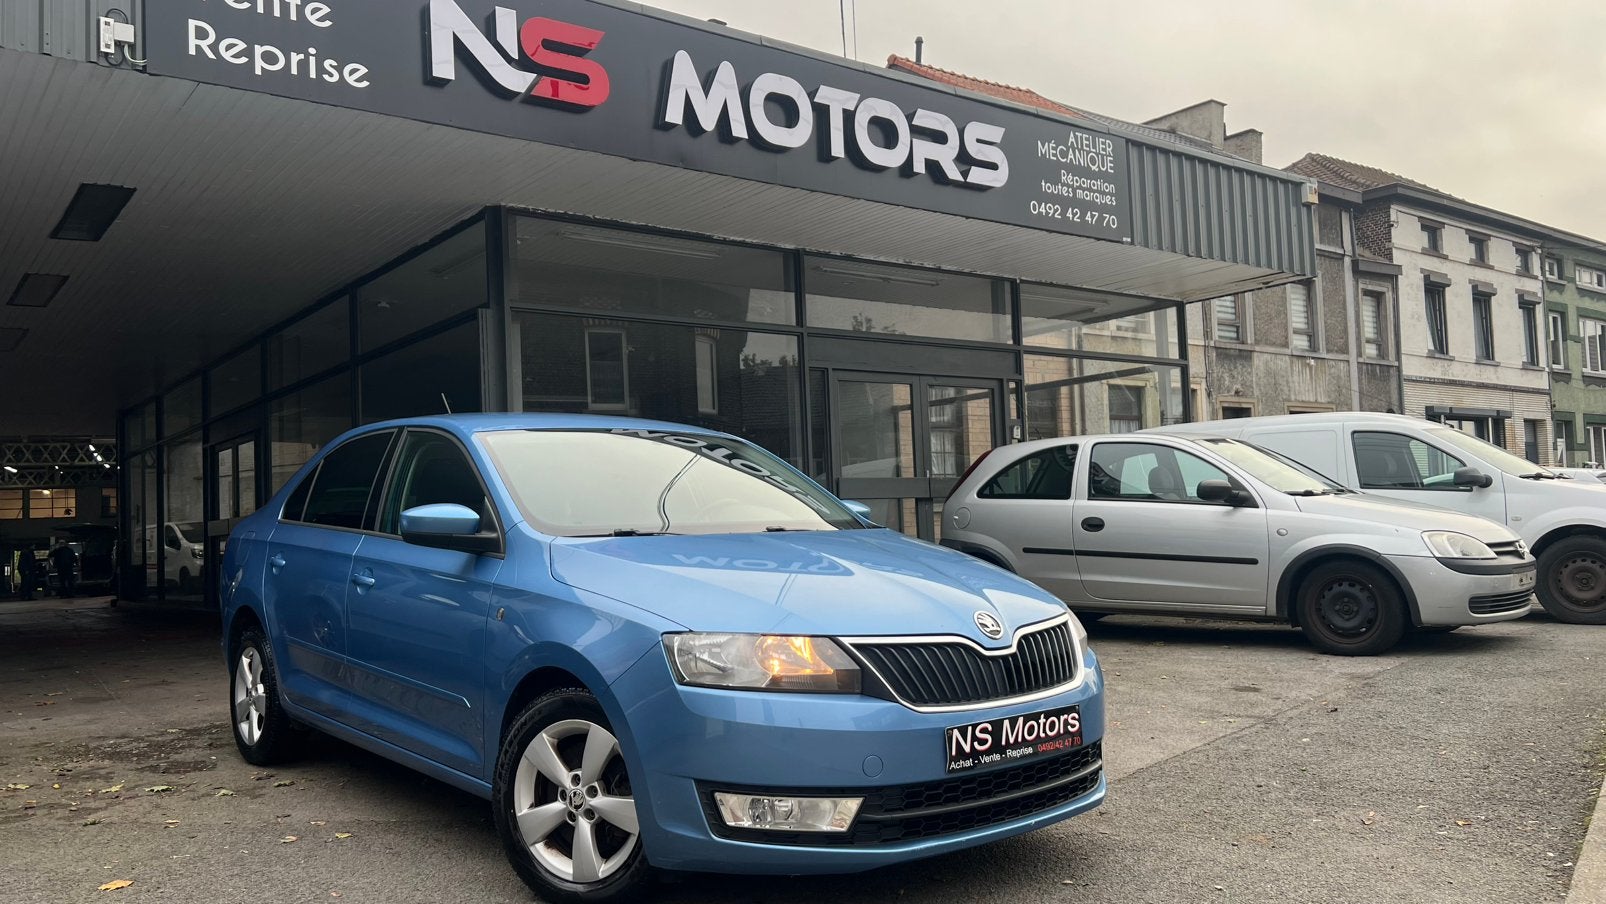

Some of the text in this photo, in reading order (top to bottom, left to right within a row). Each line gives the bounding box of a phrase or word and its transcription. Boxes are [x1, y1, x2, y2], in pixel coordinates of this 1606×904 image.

[188, 18, 370, 88] Reprise
[430, 0, 1009, 188] NS MOTORS
[1037, 139, 1114, 173] MÉCANIQUE
[1068, 130, 1113, 156] ATELIER
[1041, 179, 1116, 205] toutes marques
[1061, 169, 1115, 194] Réparation
[1030, 200, 1117, 228] 0492 42 47 70
[951, 712, 1080, 756] NS Motors
[1037, 736, 1080, 753] 0492/42 47 70
[949, 757, 973, 770] Achat
[979, 752, 1000, 764] Vente
[1006, 746, 1033, 758] Reprise
